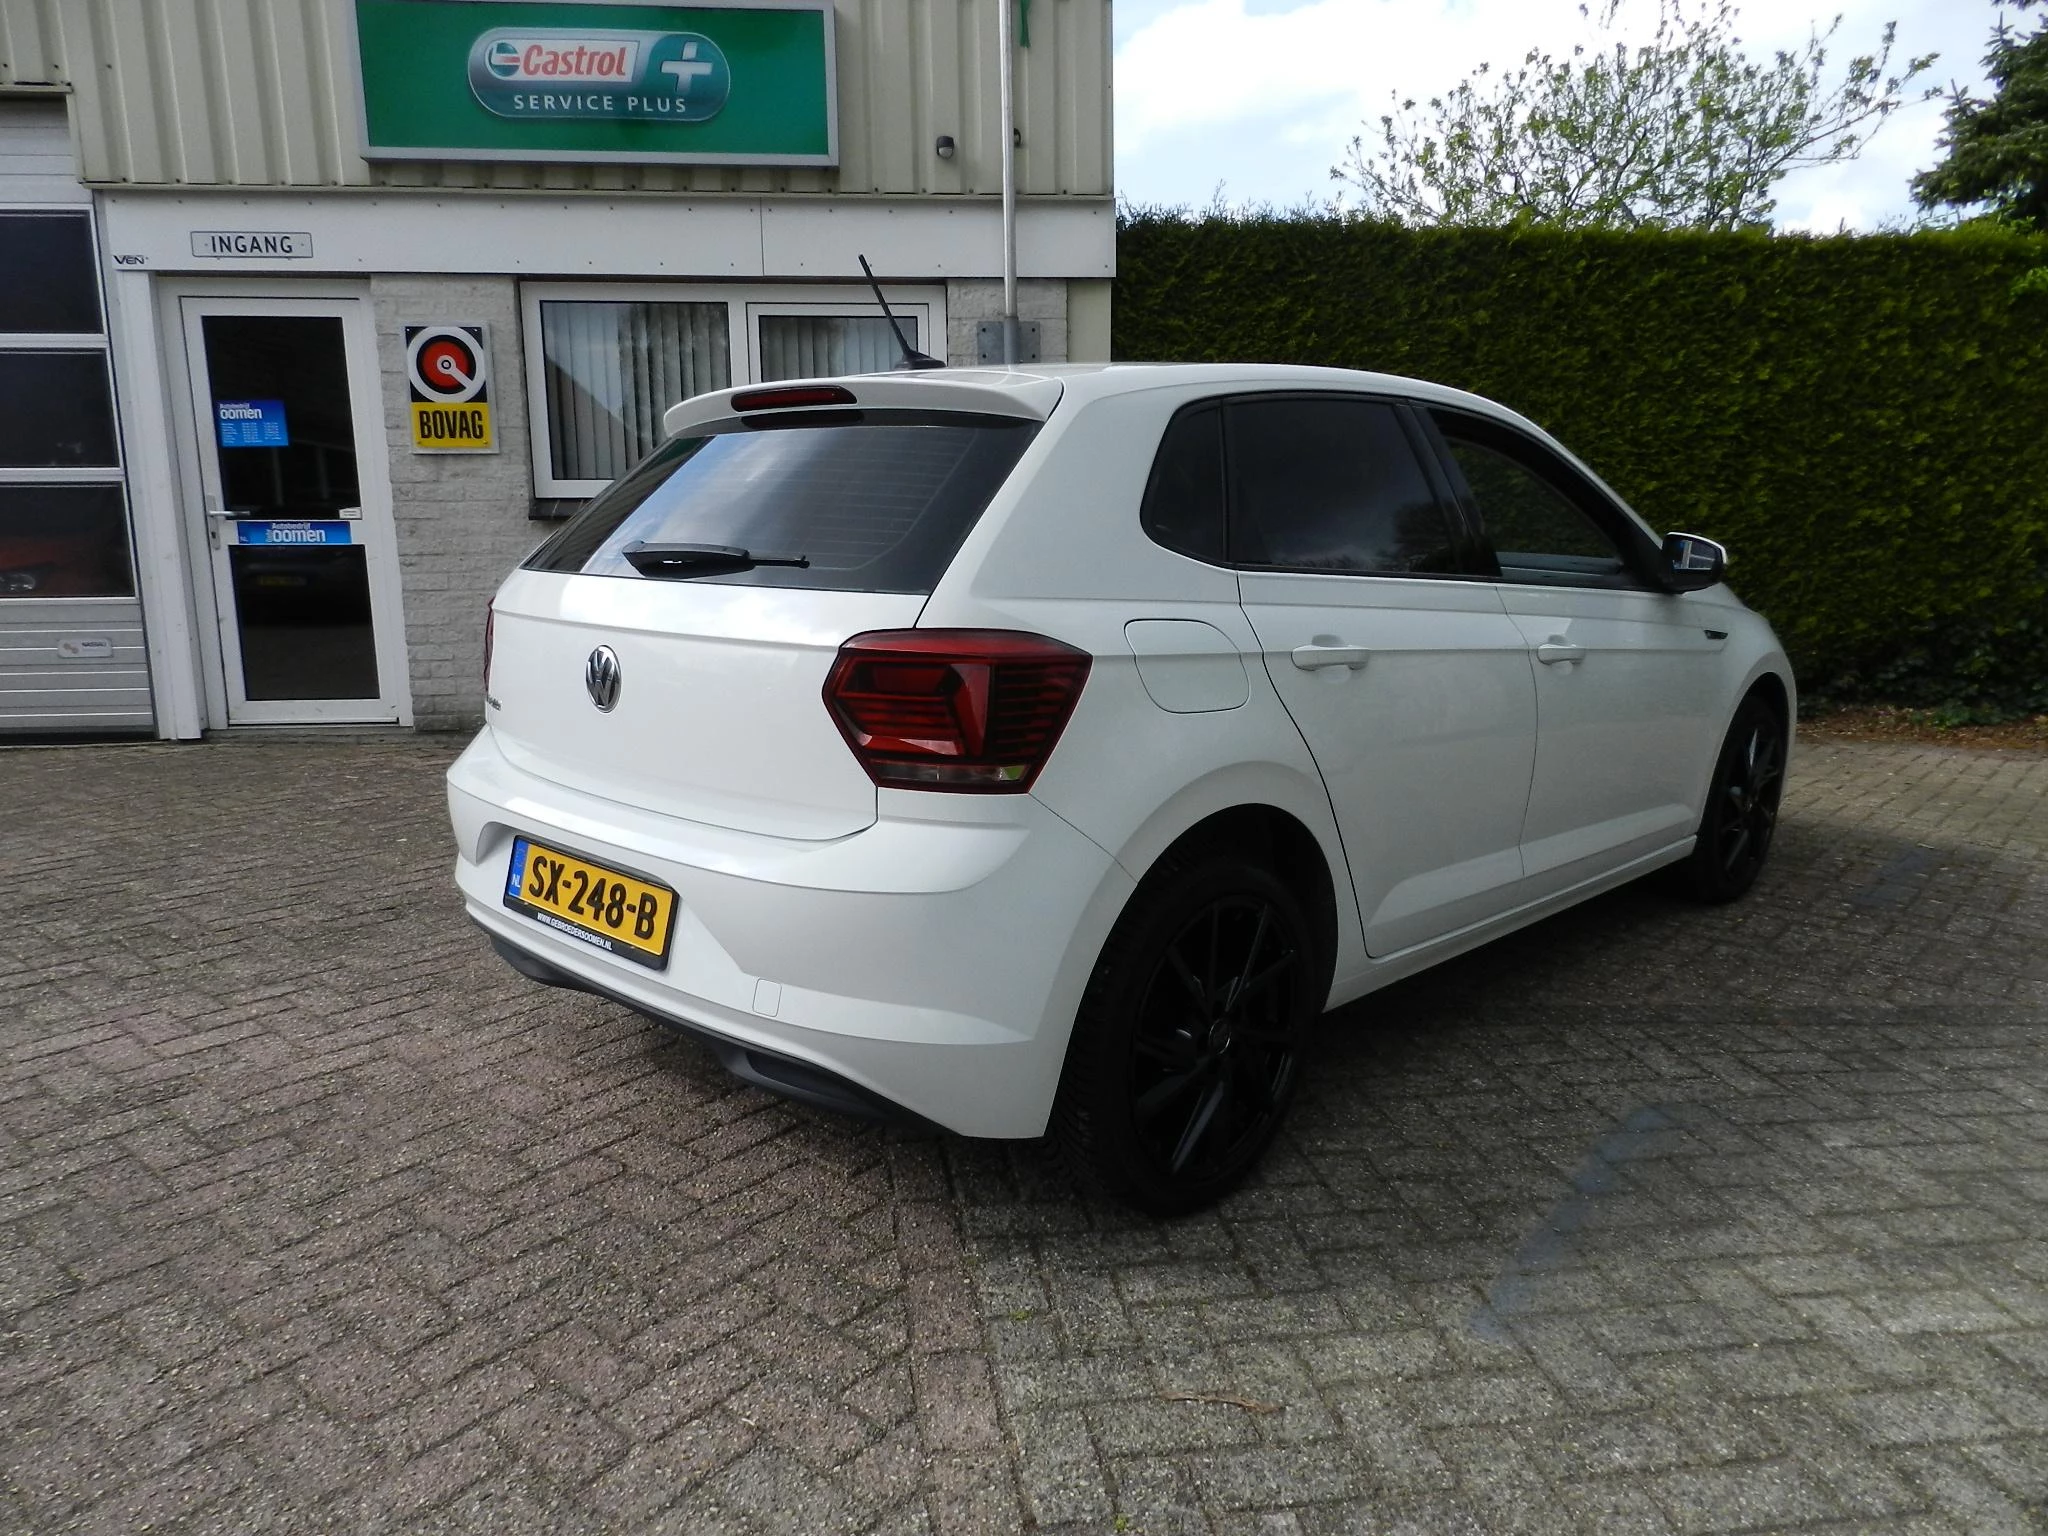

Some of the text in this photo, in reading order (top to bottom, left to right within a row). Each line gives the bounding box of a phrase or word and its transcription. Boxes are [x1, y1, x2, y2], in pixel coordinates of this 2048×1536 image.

[522, 44, 627, 77] Castrol
[514, 95, 687, 114] SERVICE PLUS
[211, 235, 293, 254] INGANG
[220, 408, 263, 420] oomen
[418, 410, 485, 439] BOVAG
[272, 528, 326, 543] oomen
[511, 873, 521, 888] NL
[528, 855, 658, 940] SX-248-B
